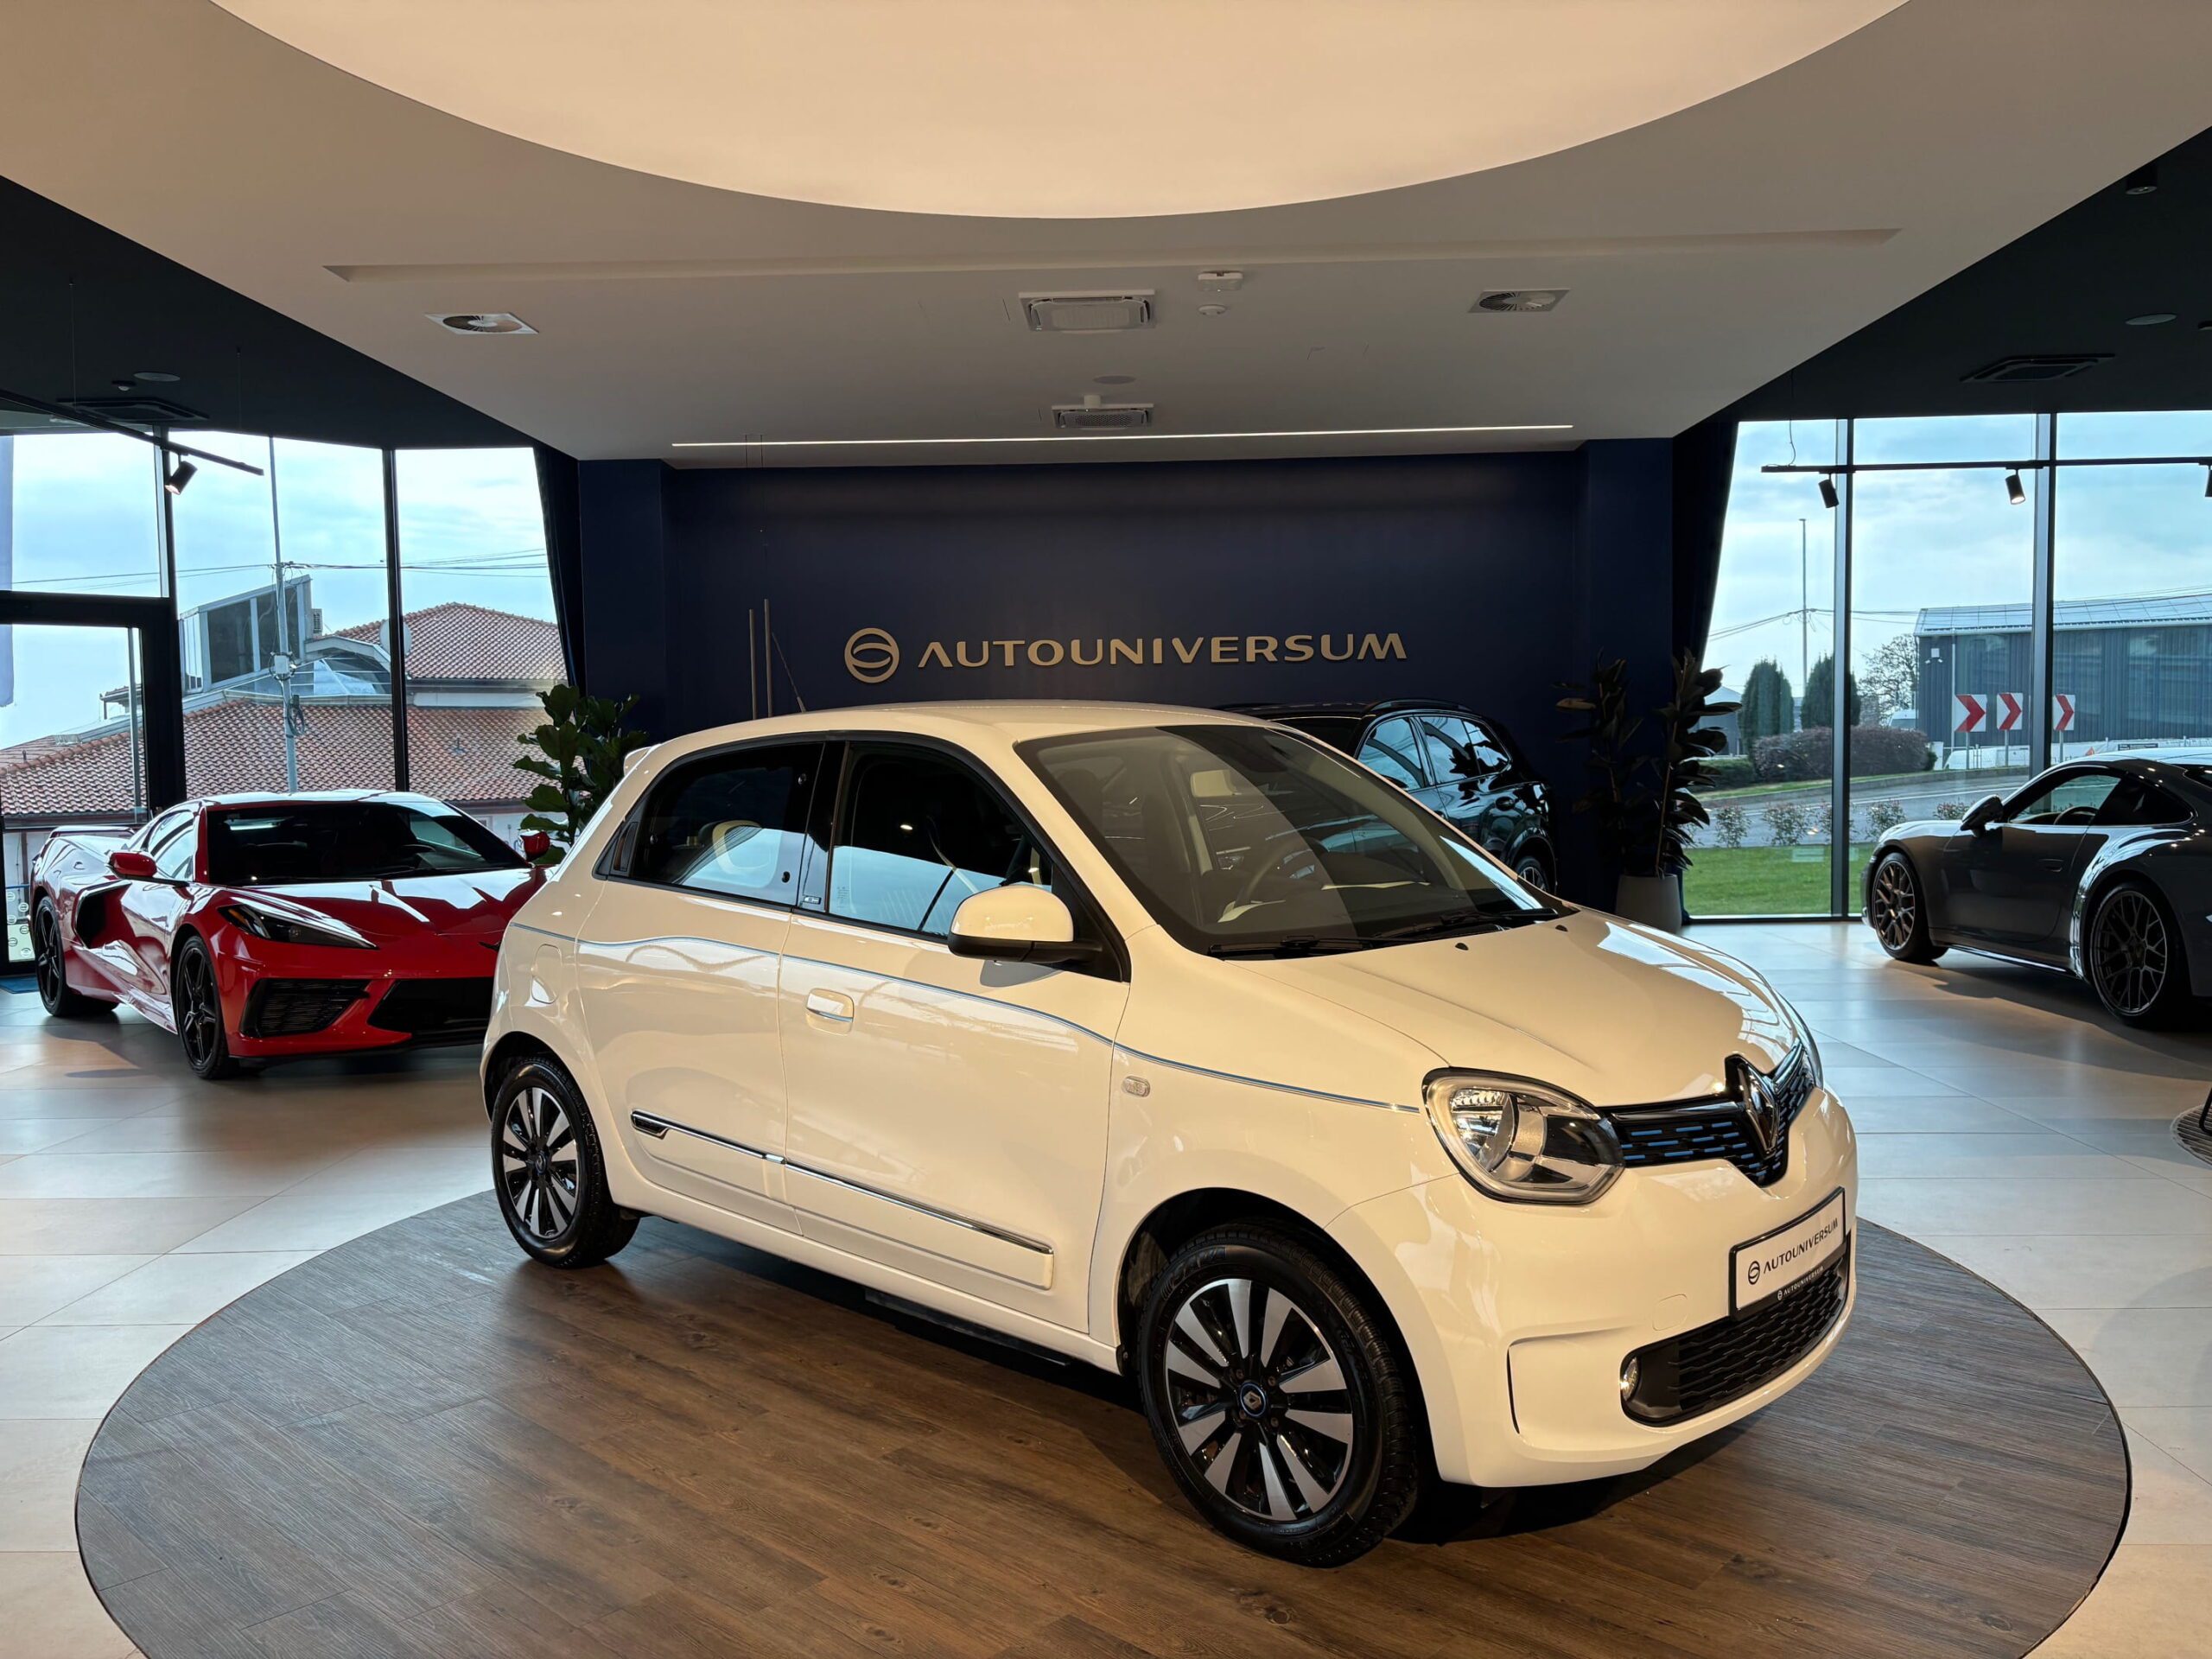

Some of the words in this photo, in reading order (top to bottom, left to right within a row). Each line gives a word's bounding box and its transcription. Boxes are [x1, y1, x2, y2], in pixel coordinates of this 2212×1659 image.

[918, 632, 1408, 668] AUTOUNIVERSUM
[1763, 1217, 1838, 1274] AUTOUNIVERSUM
[1783, 1266, 1824, 1295] AUTOUNIVERSUM
